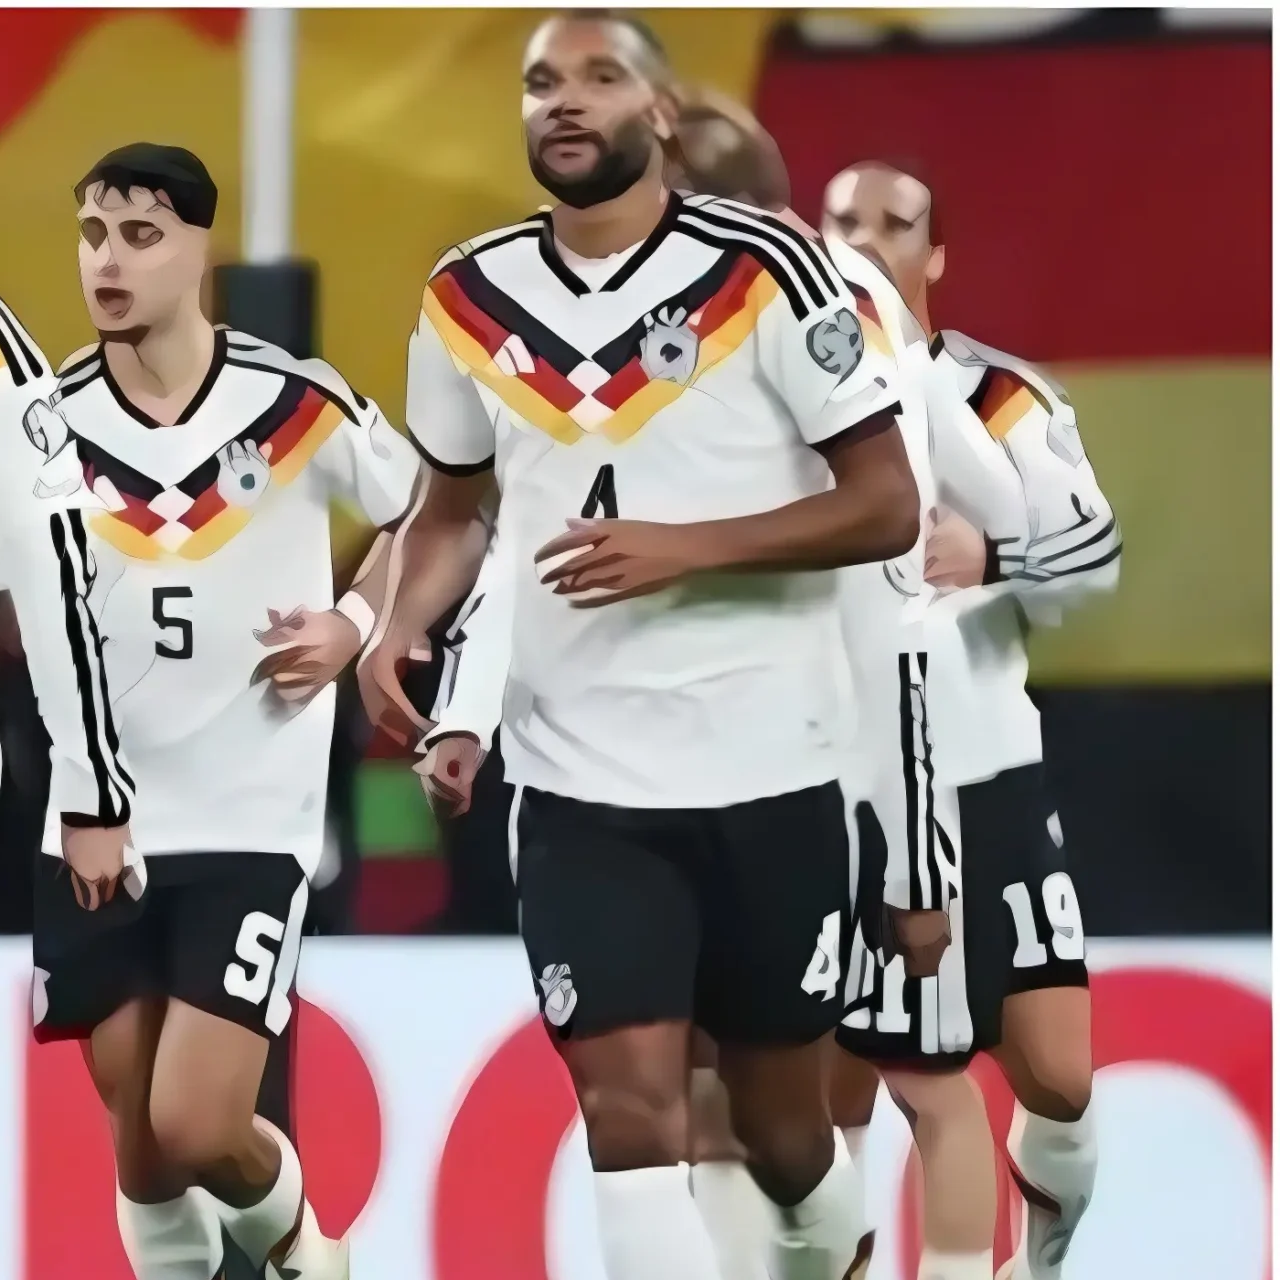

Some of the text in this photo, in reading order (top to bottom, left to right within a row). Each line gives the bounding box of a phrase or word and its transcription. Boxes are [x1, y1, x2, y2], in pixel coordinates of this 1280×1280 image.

[151, 586, 195, 660] 5
[223, 911, 285, 1005] 5
[1003, 871, 1085, 968] 19
